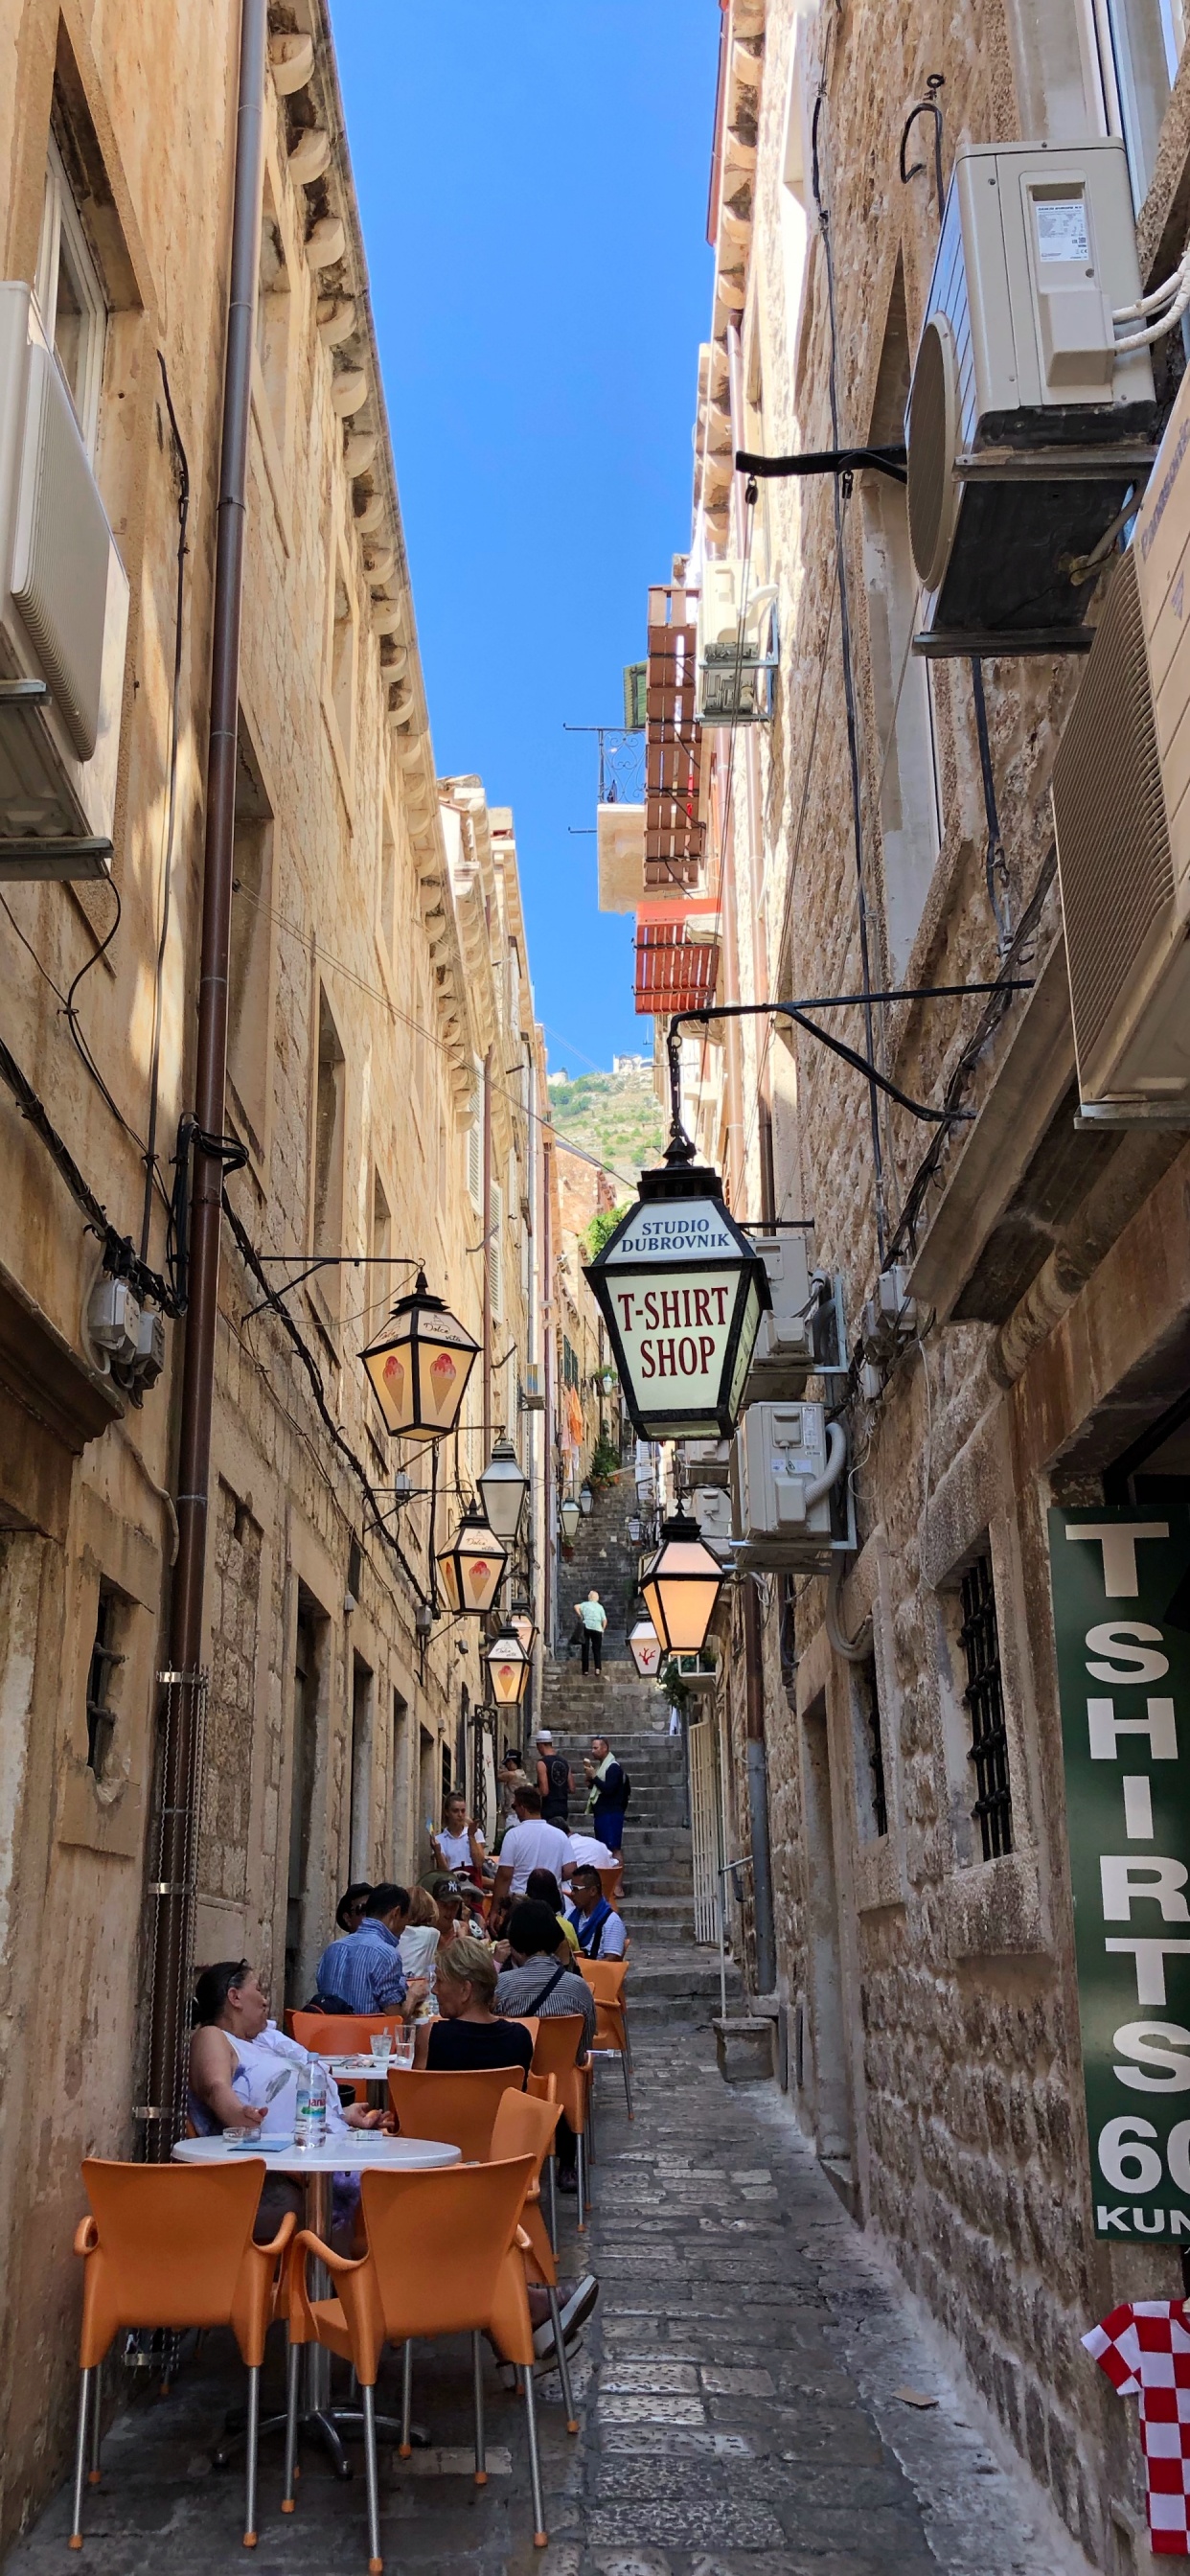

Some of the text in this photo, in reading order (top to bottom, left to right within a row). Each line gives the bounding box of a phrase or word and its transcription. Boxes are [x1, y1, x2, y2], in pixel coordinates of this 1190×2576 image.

[641, 1219, 710, 1236] STUDIO
[621, 1232, 730, 1253] DUBROVNIK
[617, 1286, 729, 1332] T-SHIRT
[423, 1322, 449, 1334] Dolce
[640, 1336, 716, 1379] SHOP
